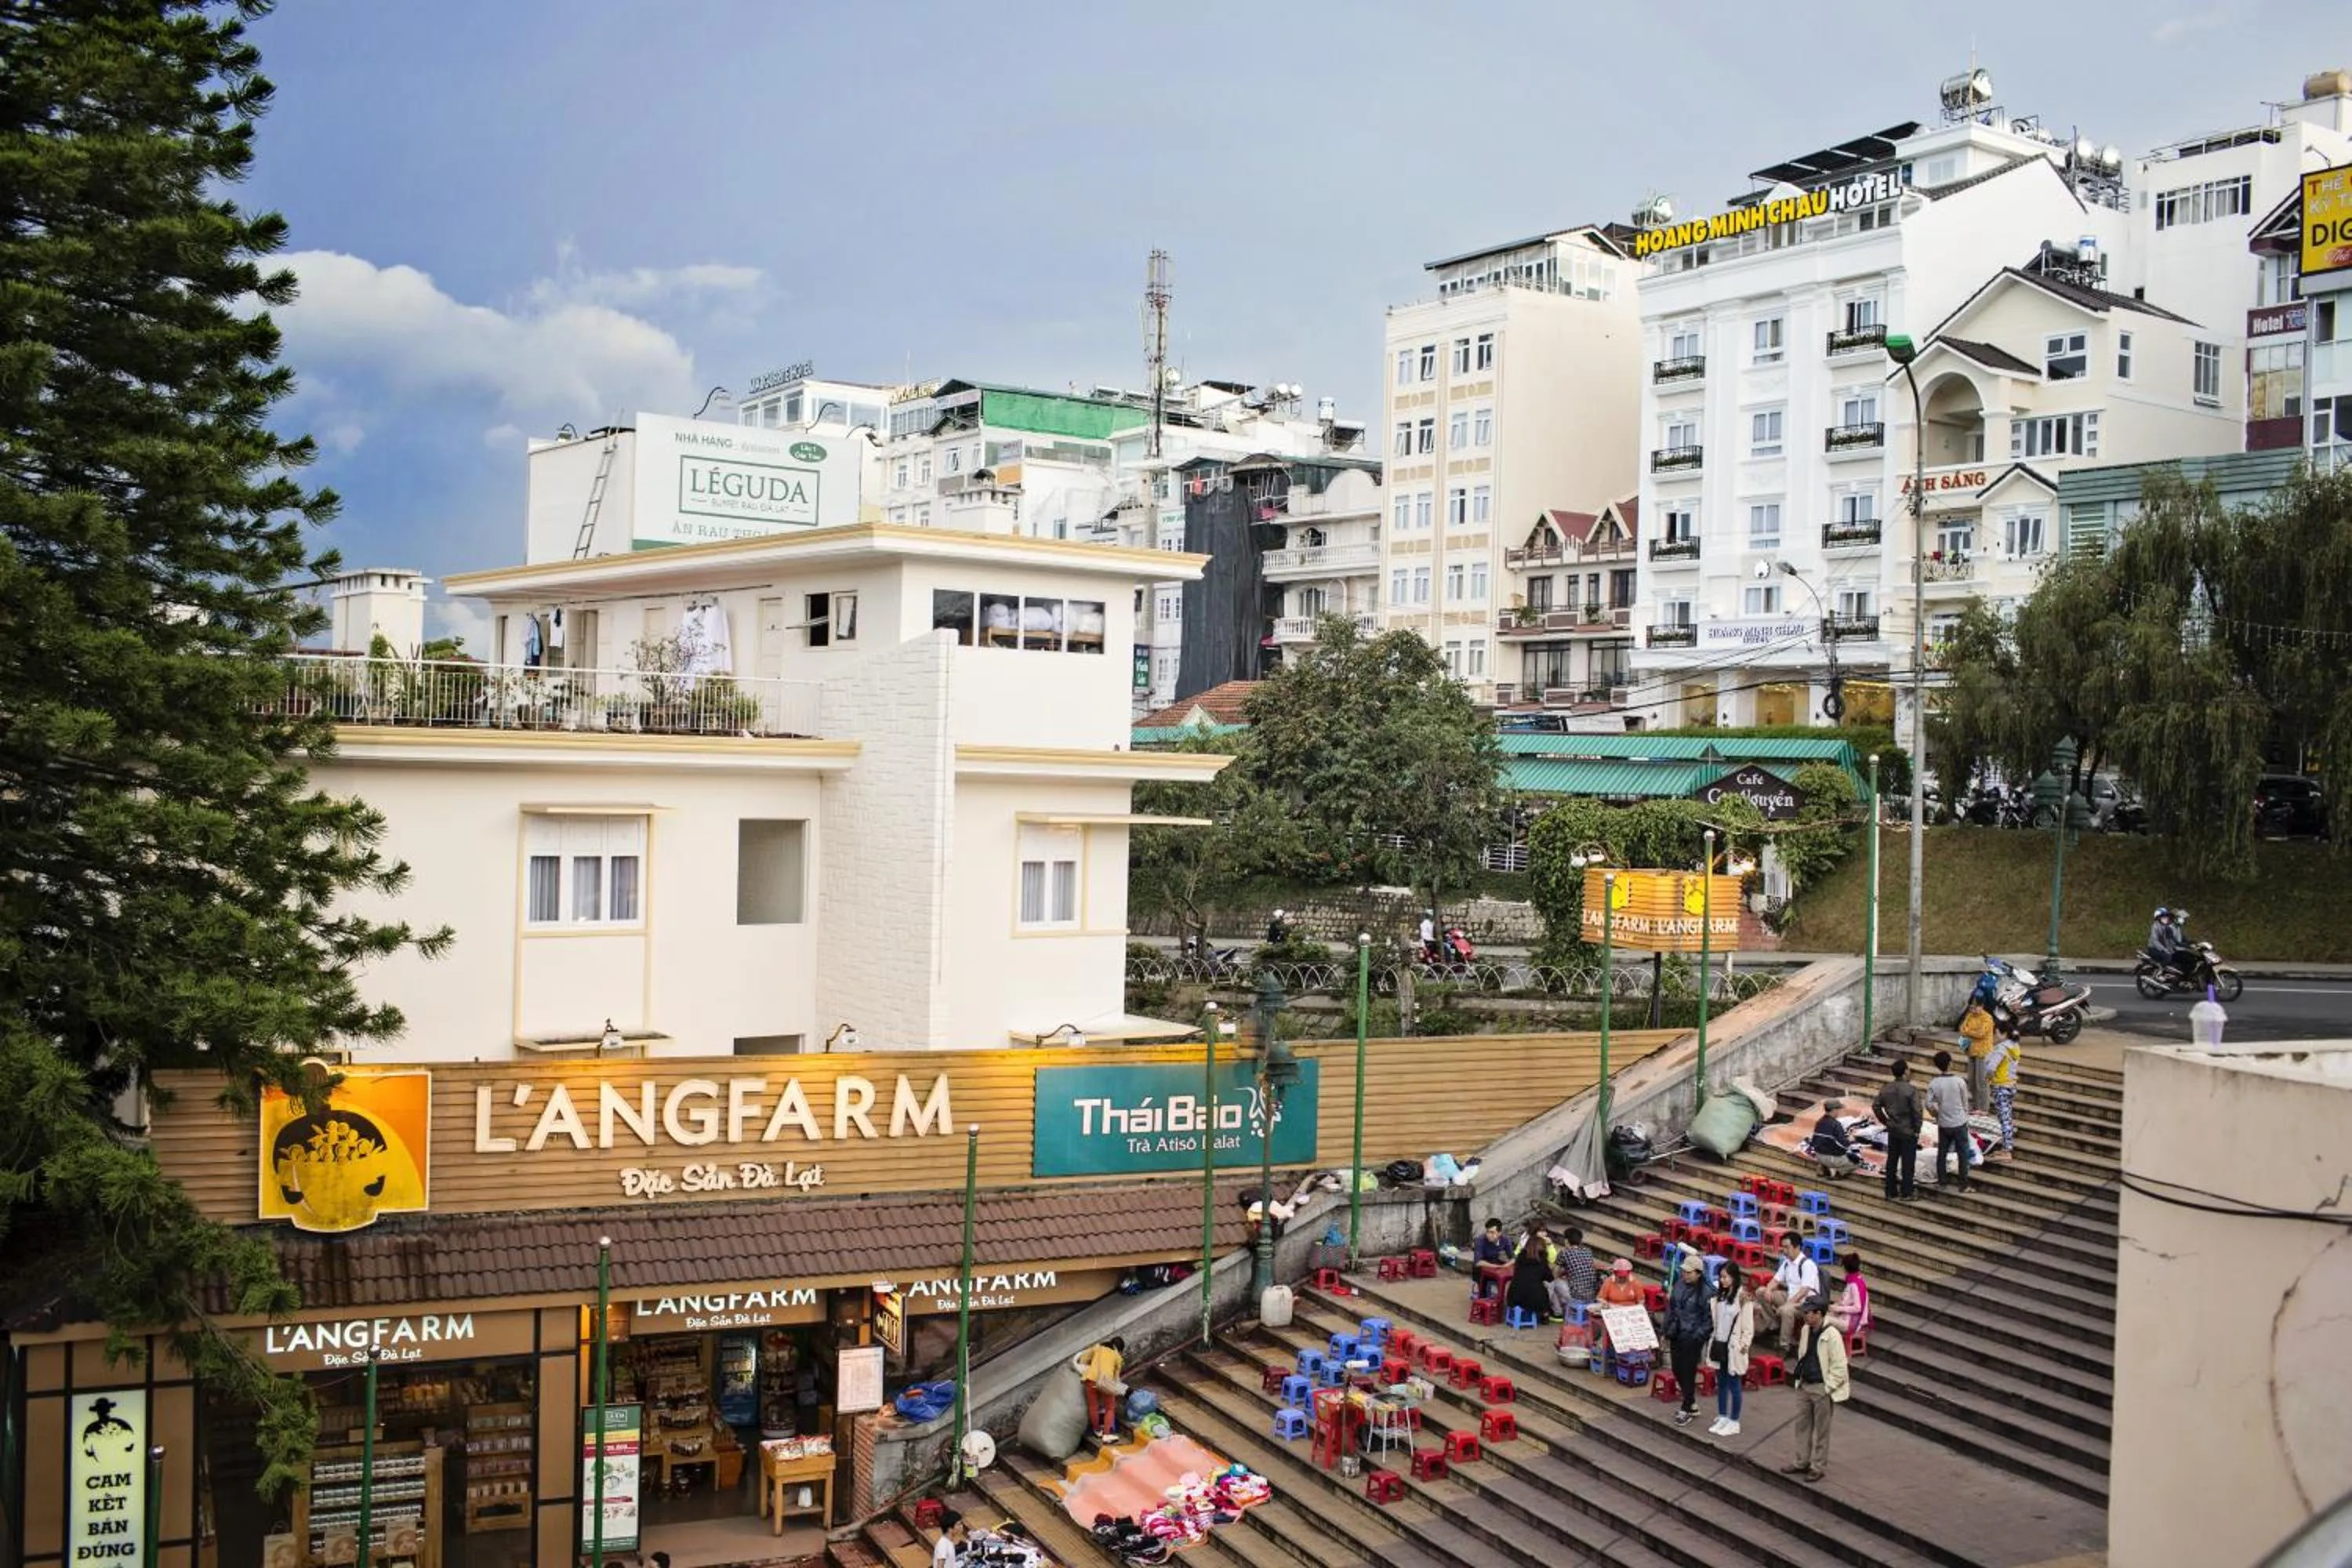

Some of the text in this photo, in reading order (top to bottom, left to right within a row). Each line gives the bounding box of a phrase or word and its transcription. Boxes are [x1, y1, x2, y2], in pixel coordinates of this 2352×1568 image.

[1635, 171, 1903, 256] HOANG MINH CHAU HOTEL
[2252, 314, 2284, 335] Hotel
[690, 466, 809, 504] LÉGUDA
[1941, 470, 1987, 489] SÁNG
[474, 1073, 953, 1152] L'ANGFARM
[1127, 1137, 1151, 1153] Trà
[1156, 1135, 1196, 1152] Atisô
[620, 1160, 826, 1200] Đặc Sản Đà Lạt
[266, 1313, 474, 1354] L'ANGFARM
[85, 1472, 132, 1490] CAM
[88, 1492, 127, 1512] KẾT
[87, 1517, 129, 1536] BÁN
[77, 1541, 136, 1559] ĐÚNG
